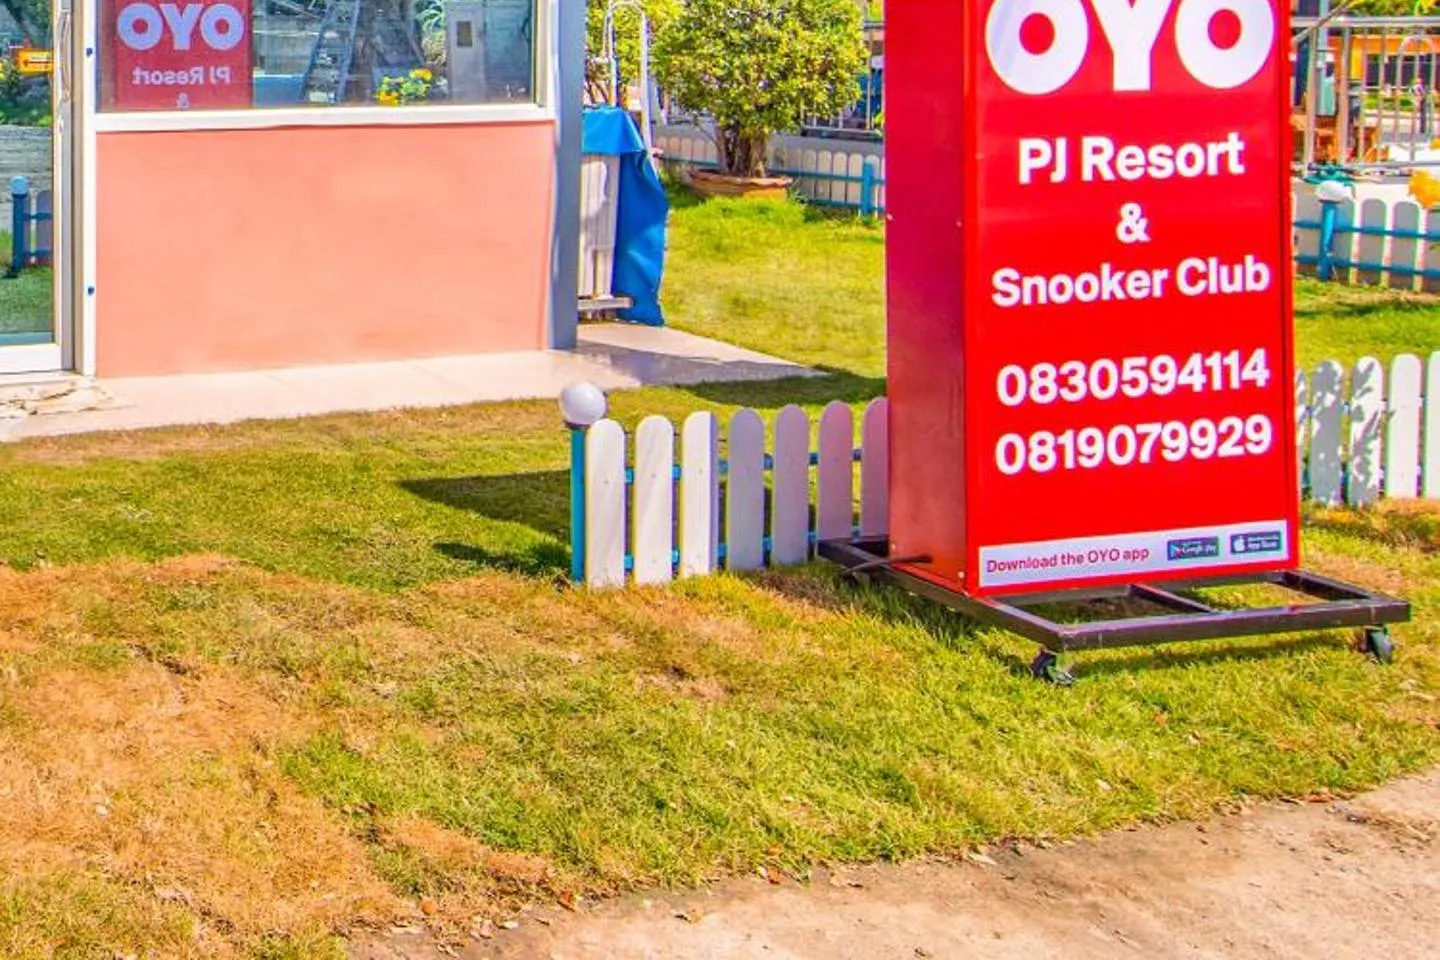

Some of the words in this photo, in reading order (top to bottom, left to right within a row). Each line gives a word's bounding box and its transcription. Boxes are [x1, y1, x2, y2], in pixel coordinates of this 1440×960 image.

[1018, 137, 1067, 185] PJ
[1080, 131, 1245, 181] Resort
[1116, 202, 1151, 243] &
[991, 263, 1169, 307] Snooker
[1176, 254, 1271, 296] Club
[995, 348, 1270, 407] 0830594114
[995, 414, 1273, 475] 0819079929
[986, 555, 1058, 573] Download
[1061, 552, 1085, 565] the
[1087, 548, 1120, 564] OYO
[1123, 547, 1149, 561] app
